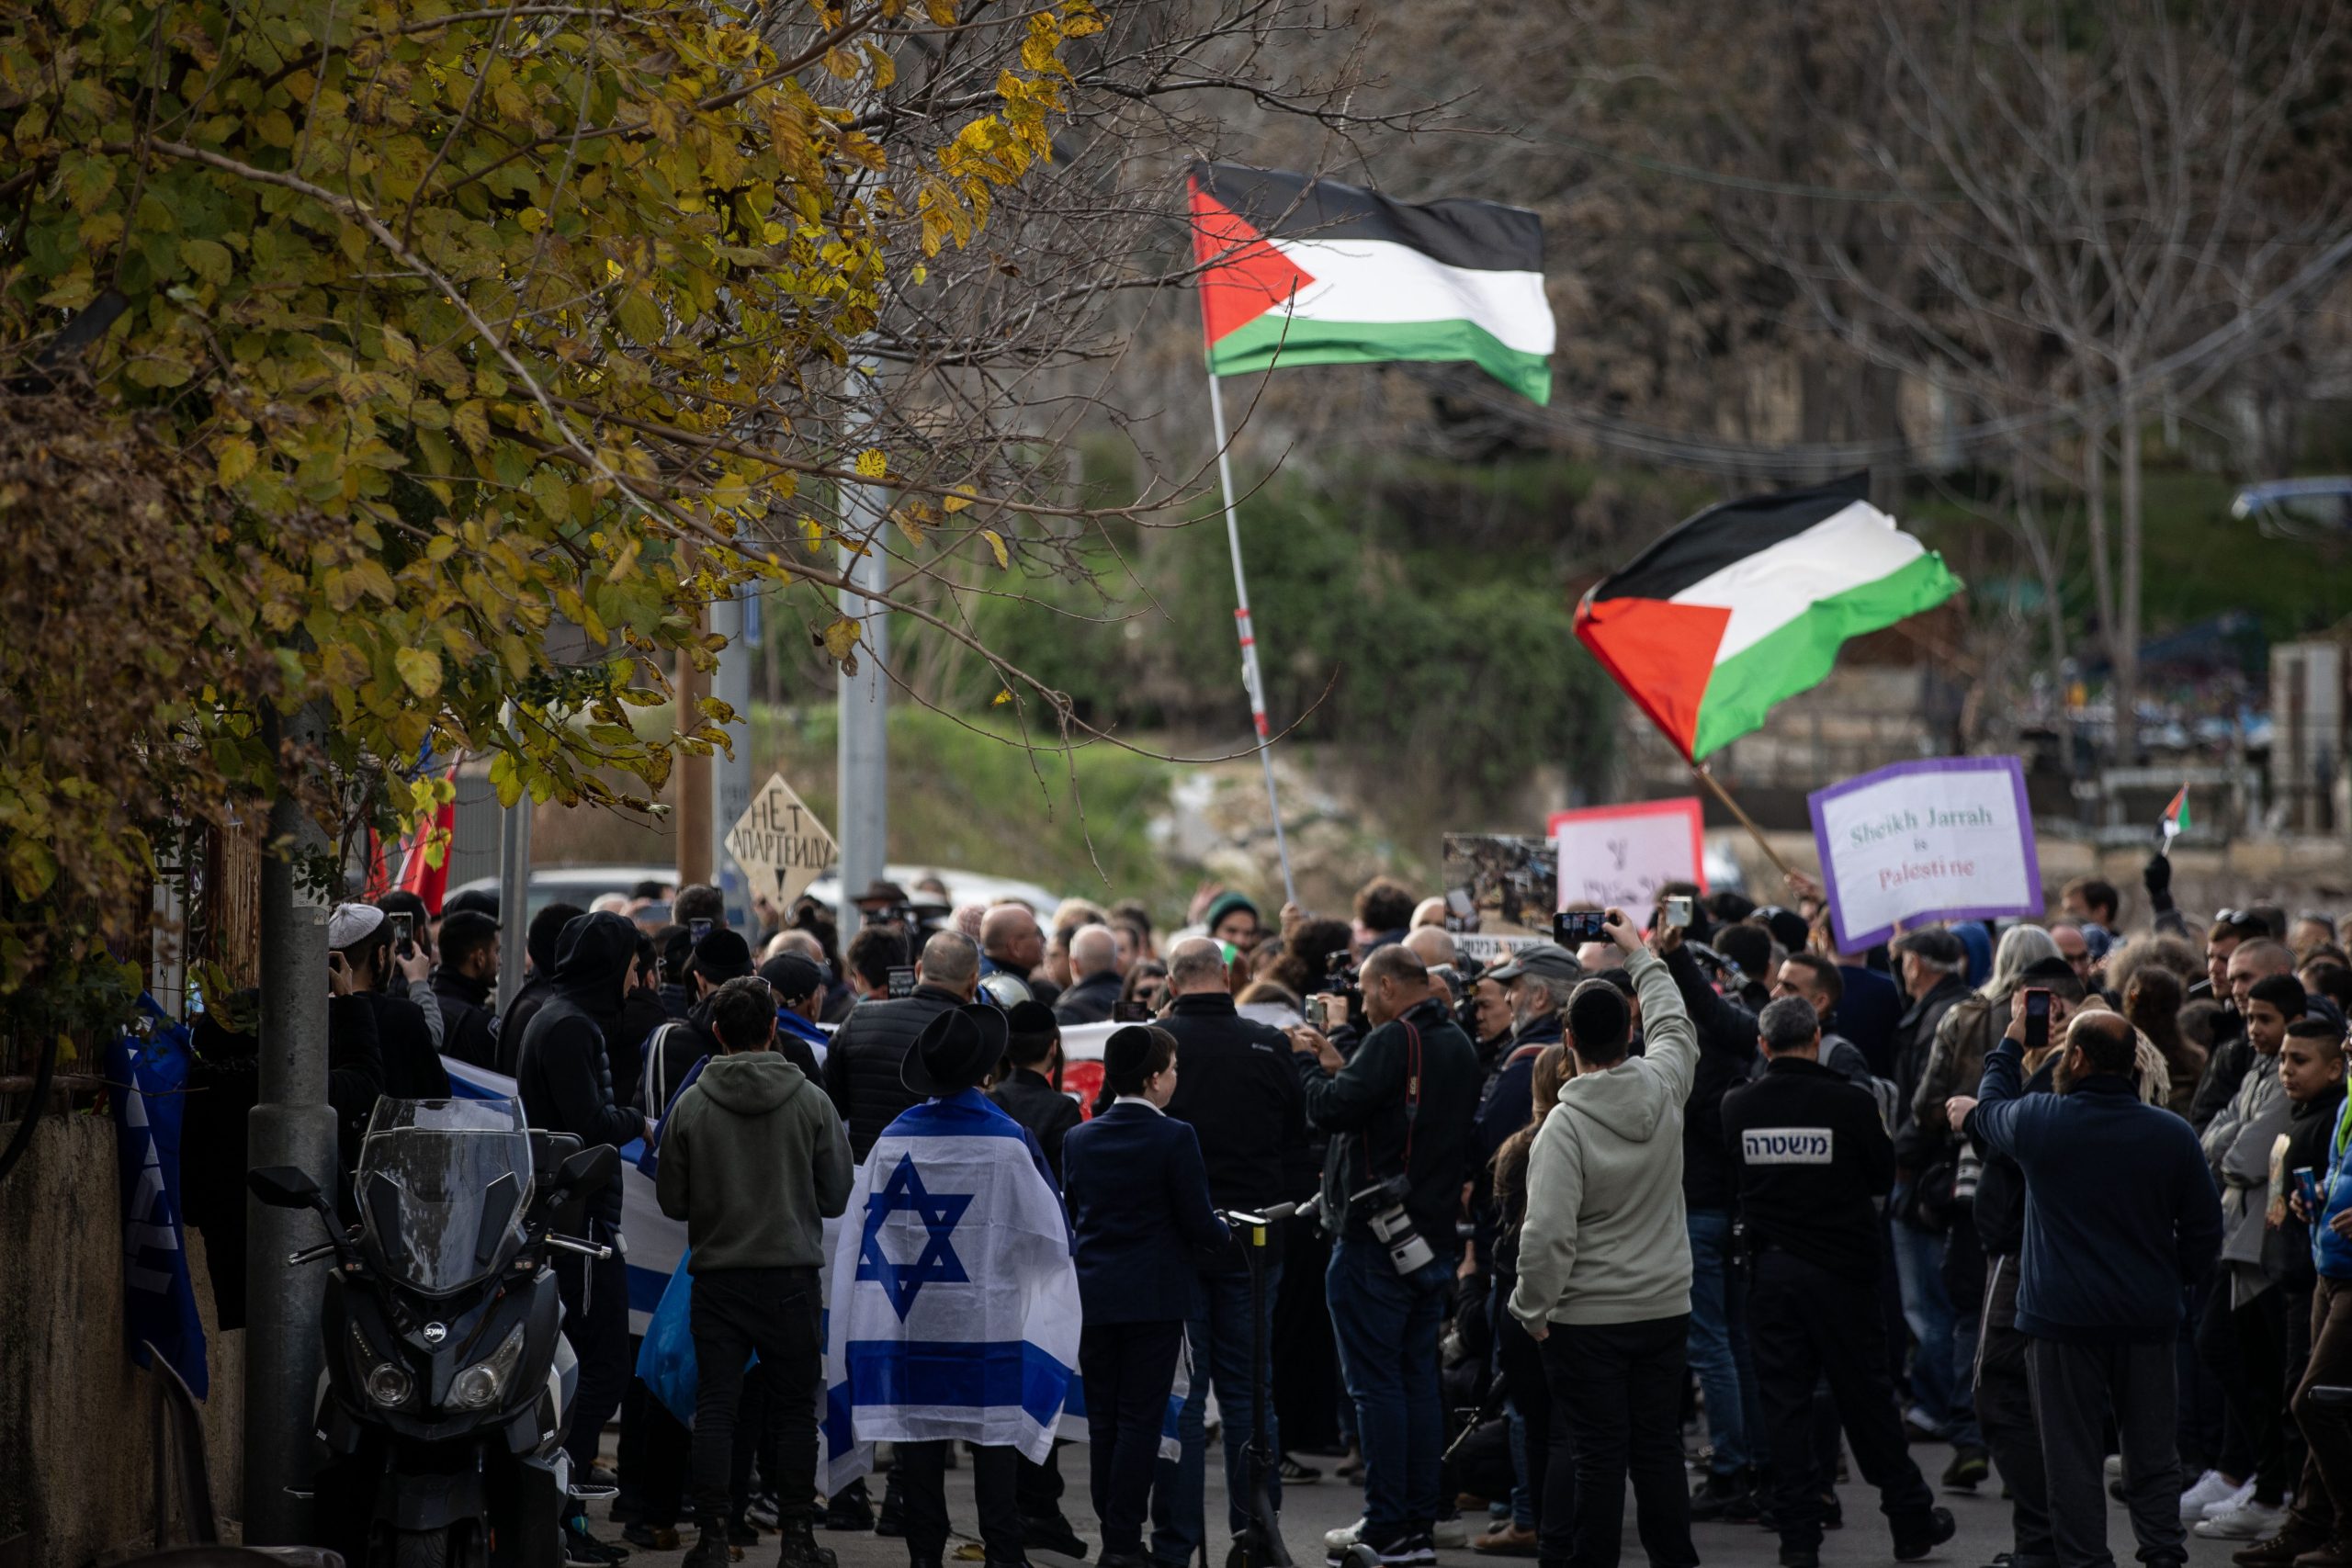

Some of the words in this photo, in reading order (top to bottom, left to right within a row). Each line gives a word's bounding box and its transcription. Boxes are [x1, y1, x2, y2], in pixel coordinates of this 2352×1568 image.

[751, 788, 803, 833] НЕТ
[1849, 807, 1919, 848] Sheikh
[1927, 803, 1993, 828] Jarrah
[1913, 837, 1928, 852] is
[1878, 854, 1975, 891] Palestine
[1746, 1135, 1827, 1156] משטרה
[425, 1328, 443, 1337] SYM
